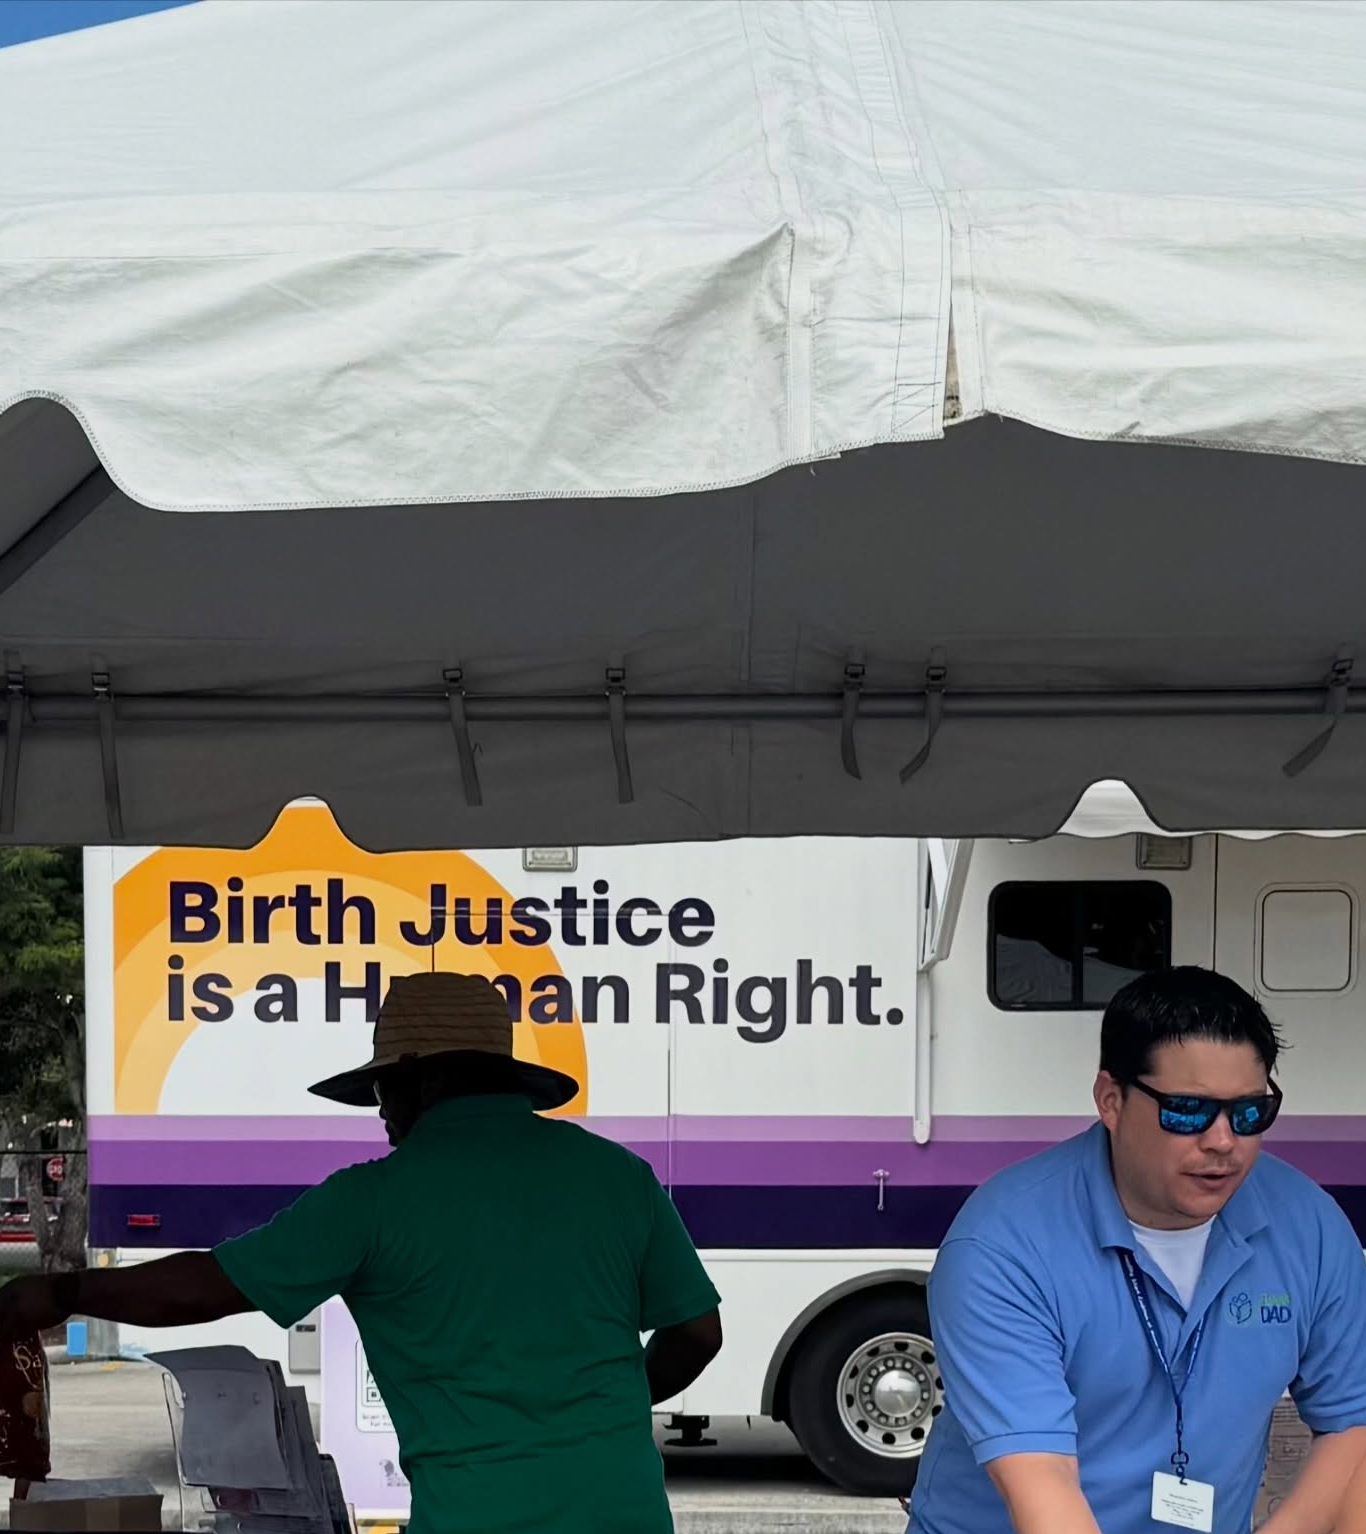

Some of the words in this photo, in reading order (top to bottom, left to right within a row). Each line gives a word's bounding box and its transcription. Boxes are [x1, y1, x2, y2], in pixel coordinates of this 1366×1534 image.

[169, 876, 376, 945] Birth
[399, 879, 715, 947] Justice
[168, 954, 234, 1023] is
[254, 973, 298, 1023] a
[325, 961, 630, 1025] Han
[656, 958, 904, 1044] Right.
[1261, 1306, 1292, 1323] DAD
